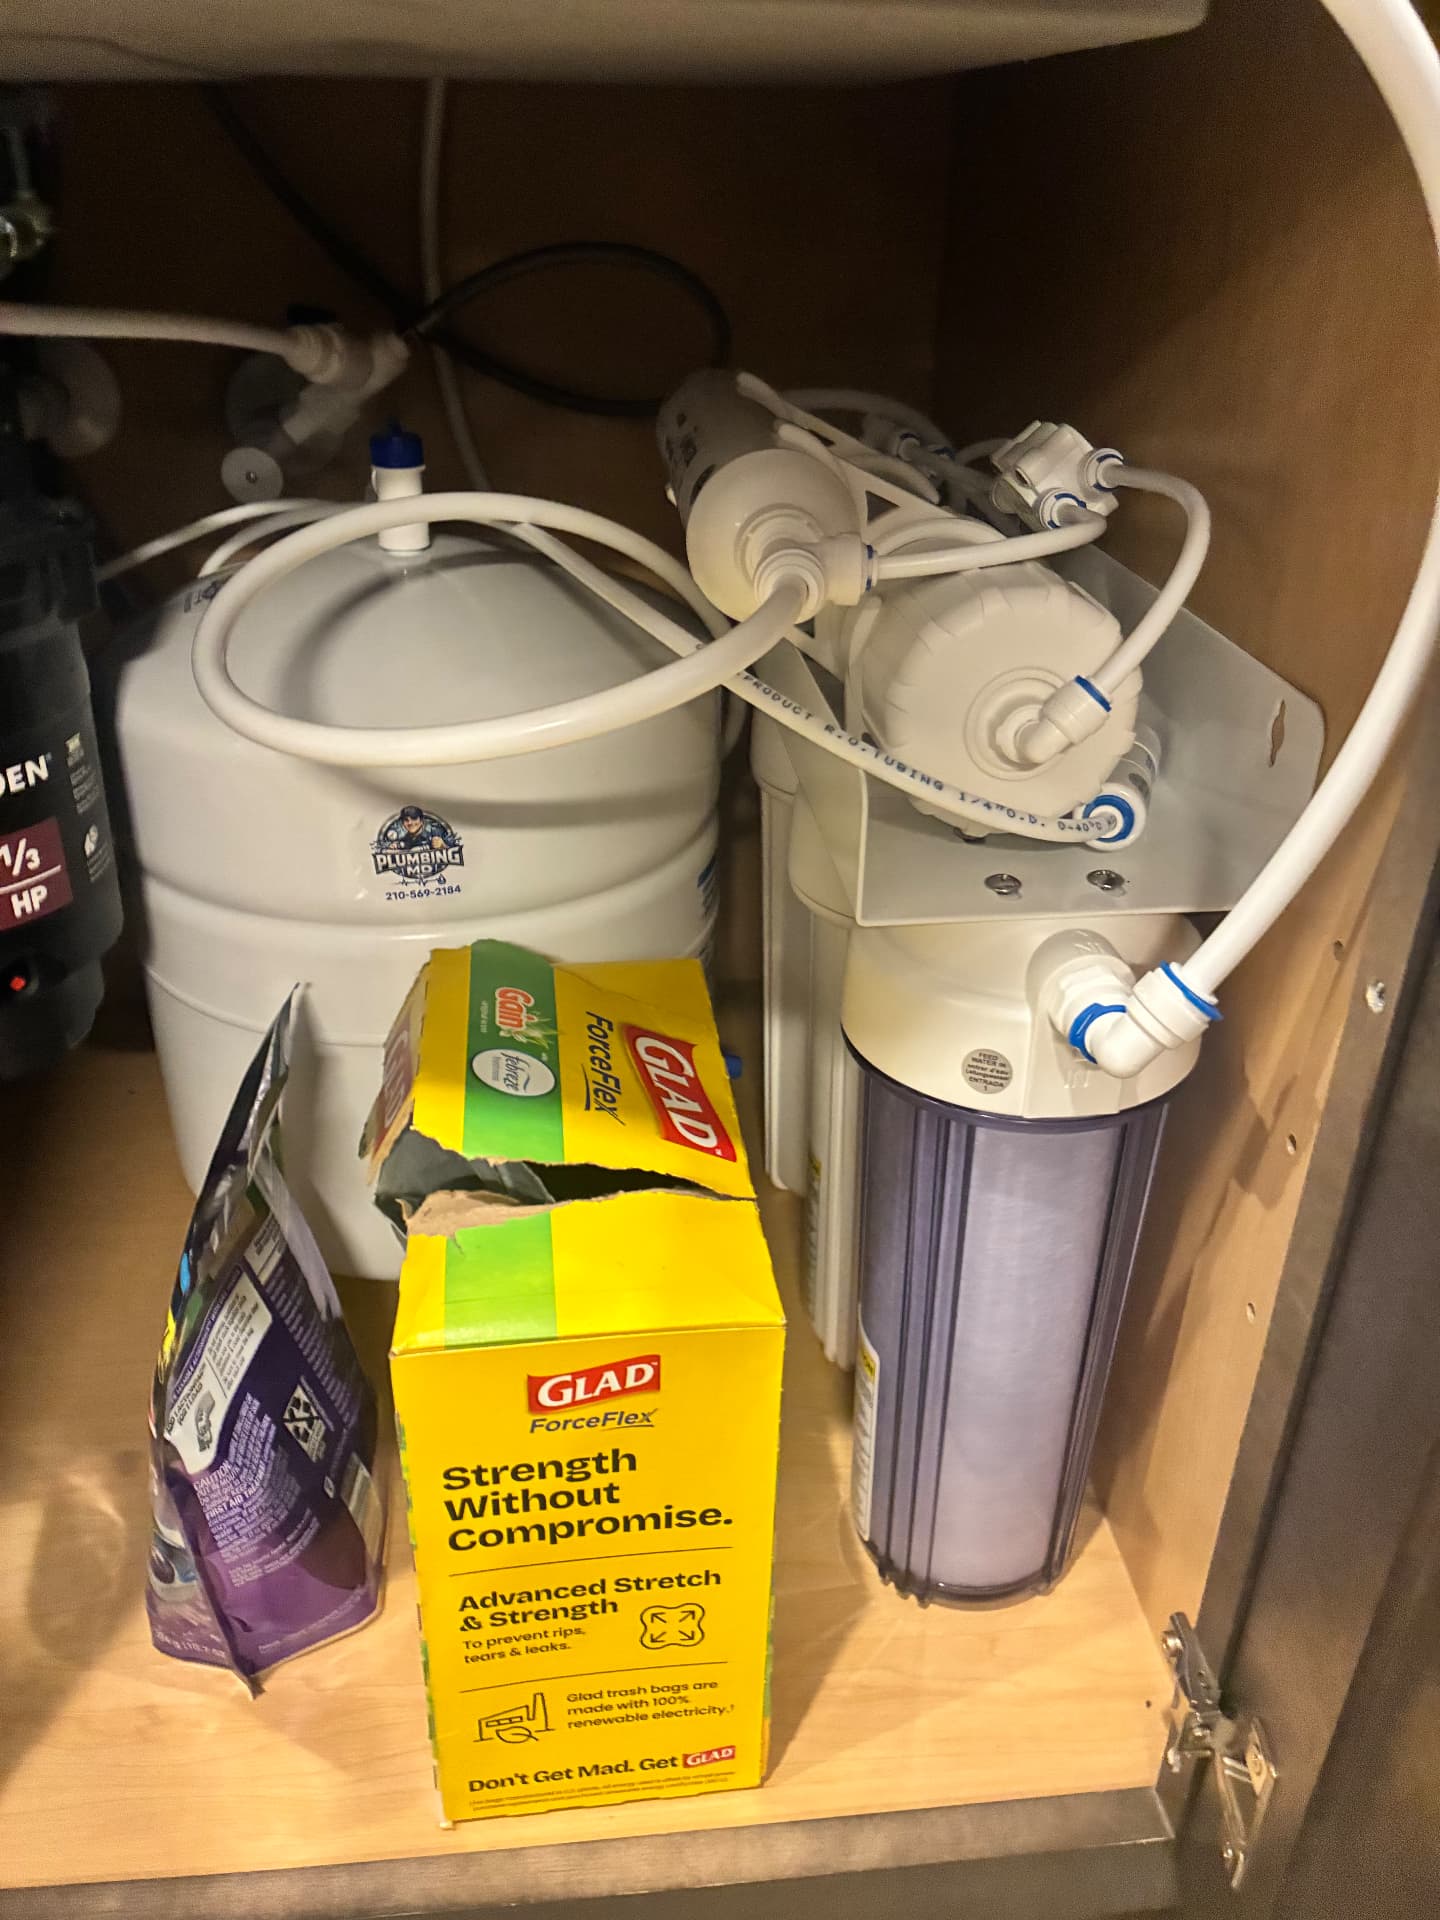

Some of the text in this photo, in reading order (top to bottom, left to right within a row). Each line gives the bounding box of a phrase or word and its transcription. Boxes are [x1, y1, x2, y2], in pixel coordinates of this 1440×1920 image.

[375, 847, 461, 869] PLUMBING
[407, 864, 433, 876] MD
[11, 884, 48, 919] HP
[385, 885, 461, 900] 210-569-2184
[495, 987, 535, 1031] Gain
[500, 1052, 530, 1091] febreze
[586, 1010, 626, 1126] ForceFlex
[635, 1036, 718, 1149] GLAD
[537, 1363, 654, 1407] GLAD
[530, 1408, 658, 1433] ForceFlex
[443, 1448, 637, 1490] Strength
[444, 1483, 620, 1521] Without
[449, 1505, 733, 1551] Compromise.
[458, 1570, 721, 1611] Advanced Stretch
[459, 1599, 618, 1631] & Strength
[463, 1640, 482, 1650] To
[486, 1630, 549, 1649] prevent
[464, 1642, 571, 1663] tears & leaks.
[566, 1681, 718, 1702] Glad trash bags are
[567, 1695, 689, 1715] made with 100%
[568, 1713, 648, 1728] renewable
[469, 1747, 733, 1792] Don't Get Mad. Get GLAD
